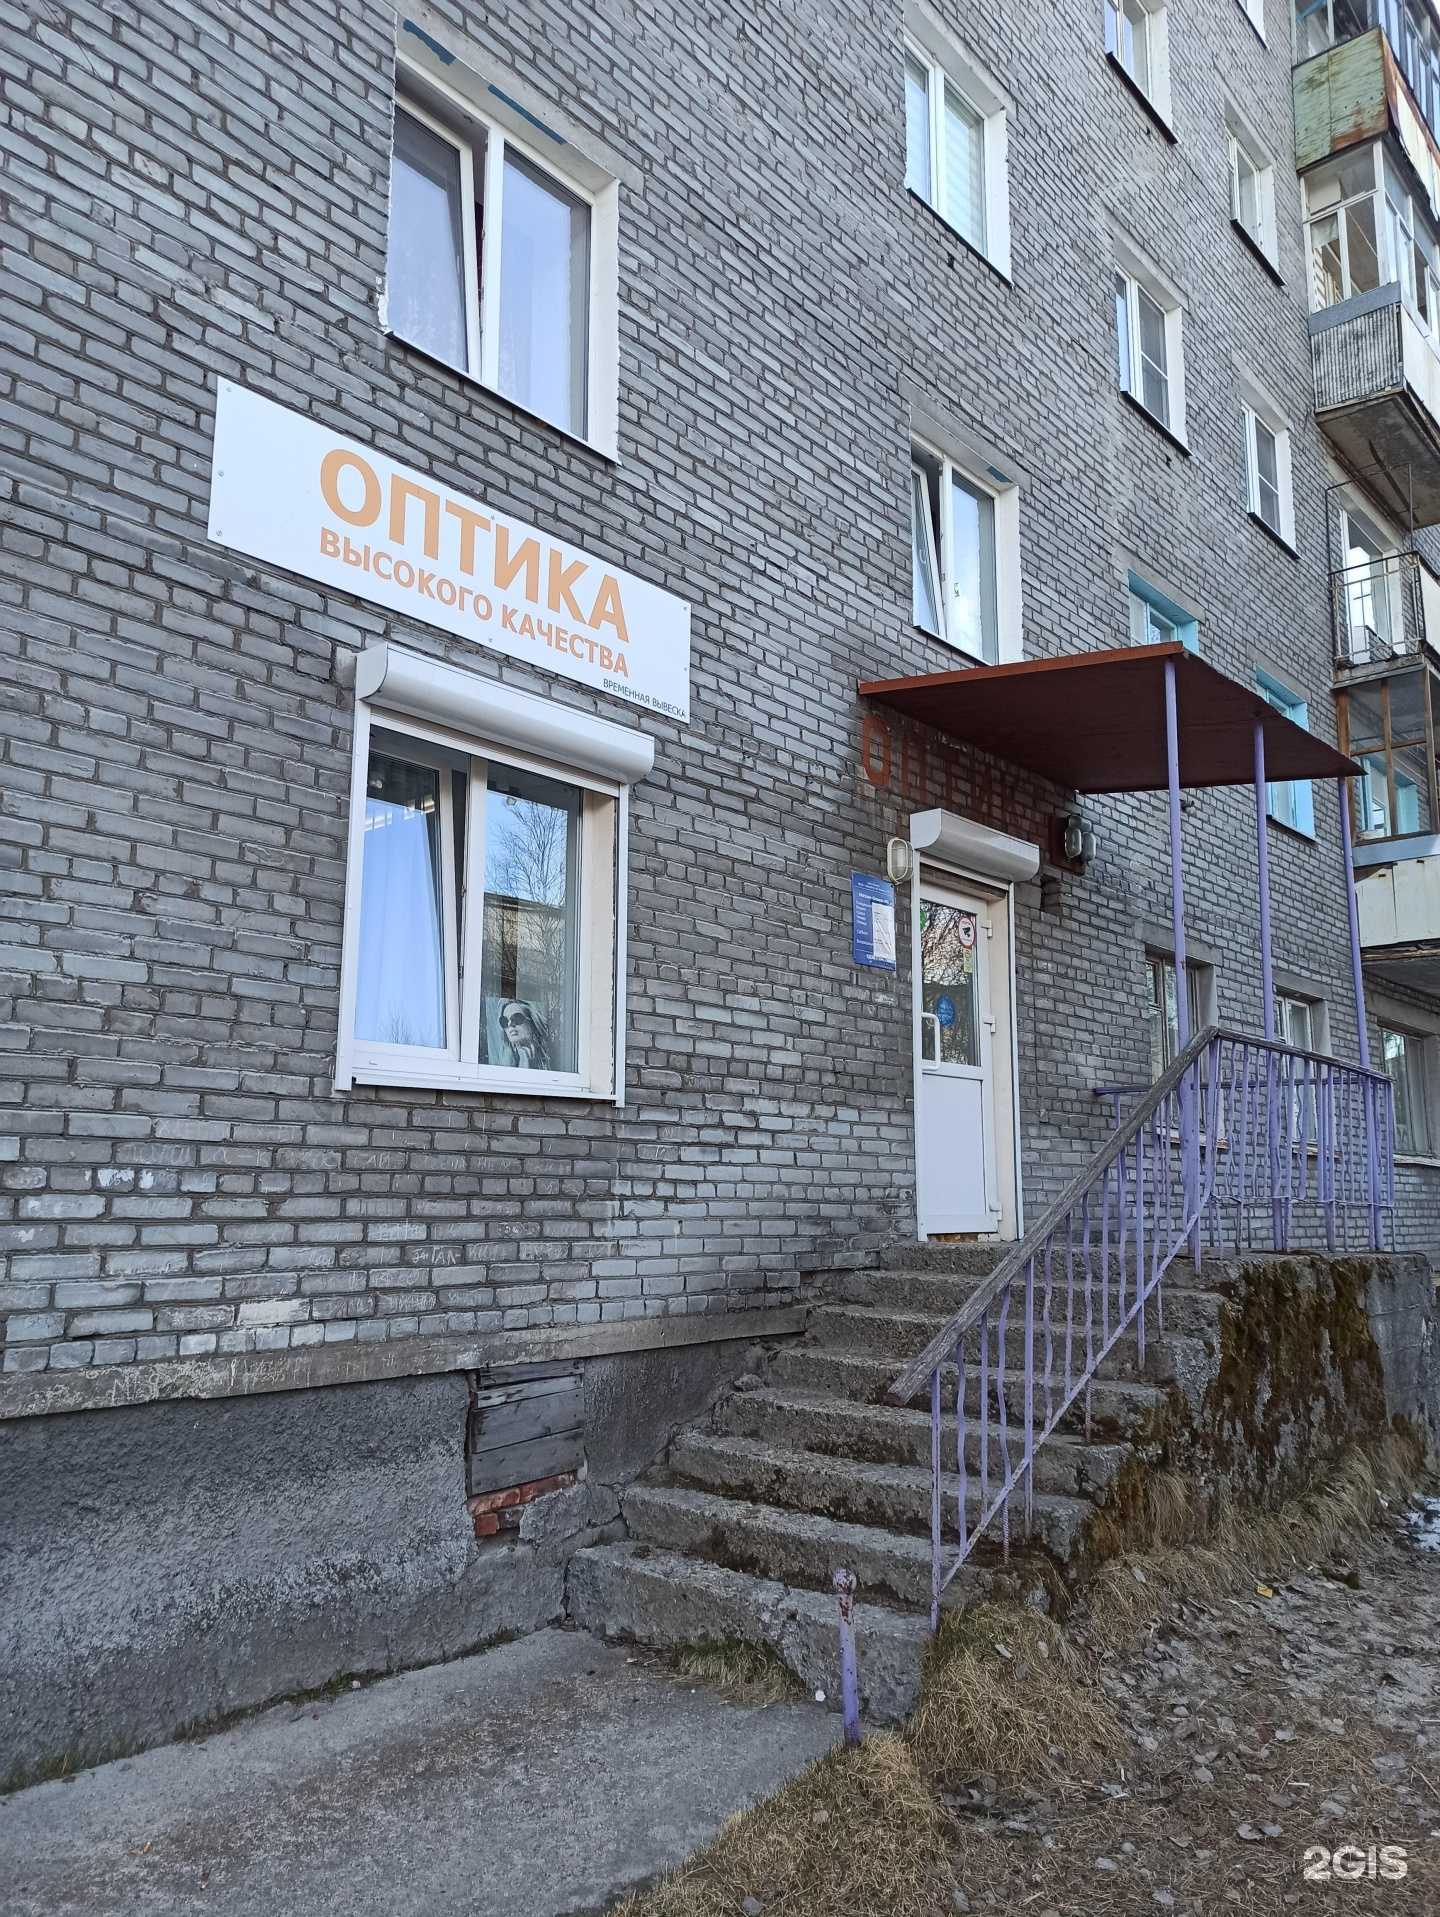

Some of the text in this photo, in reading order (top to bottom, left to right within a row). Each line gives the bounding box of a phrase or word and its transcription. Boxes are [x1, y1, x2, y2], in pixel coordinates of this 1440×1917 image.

[319, 448, 630, 643] ОПТИКА
[319, 527, 630, 678] ВЫСОКОГО КАЧЕСТВА
[603, 679, 686, 718] ВРЕМЕННАЯ ВЫВЕСКА
